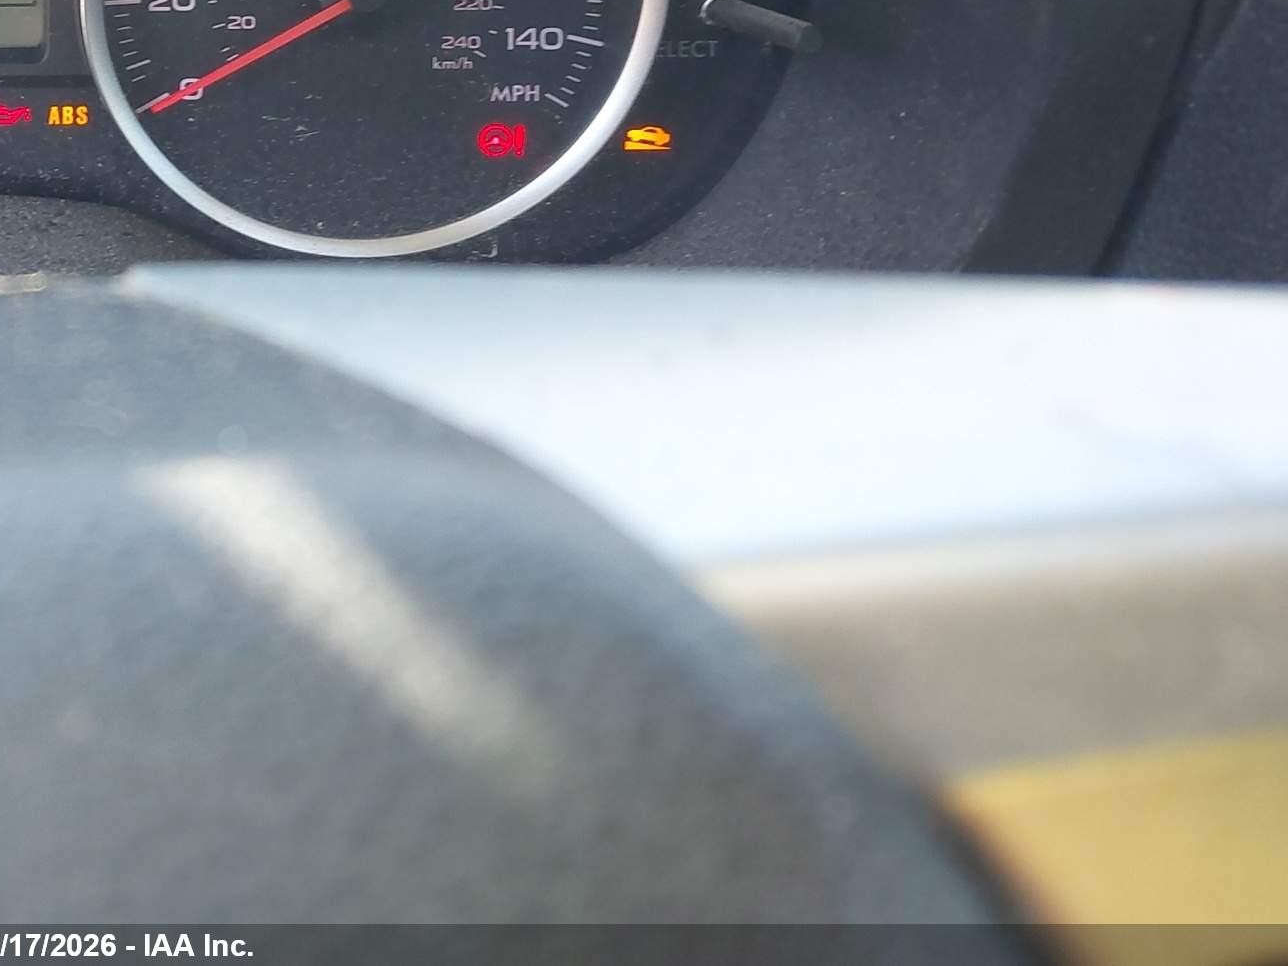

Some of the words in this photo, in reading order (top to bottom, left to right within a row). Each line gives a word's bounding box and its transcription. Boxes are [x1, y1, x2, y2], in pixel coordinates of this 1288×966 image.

[227, 16, 256, 30] 20
[441, 36, 482, 49] 240
[505, 27, 564, 51] 140
[654, 40, 720, 58] ELECT
[431, 57, 473, 70] km/h
[489, 84, 541, 102] MPH
[48, 105, 89, 125] ABS
